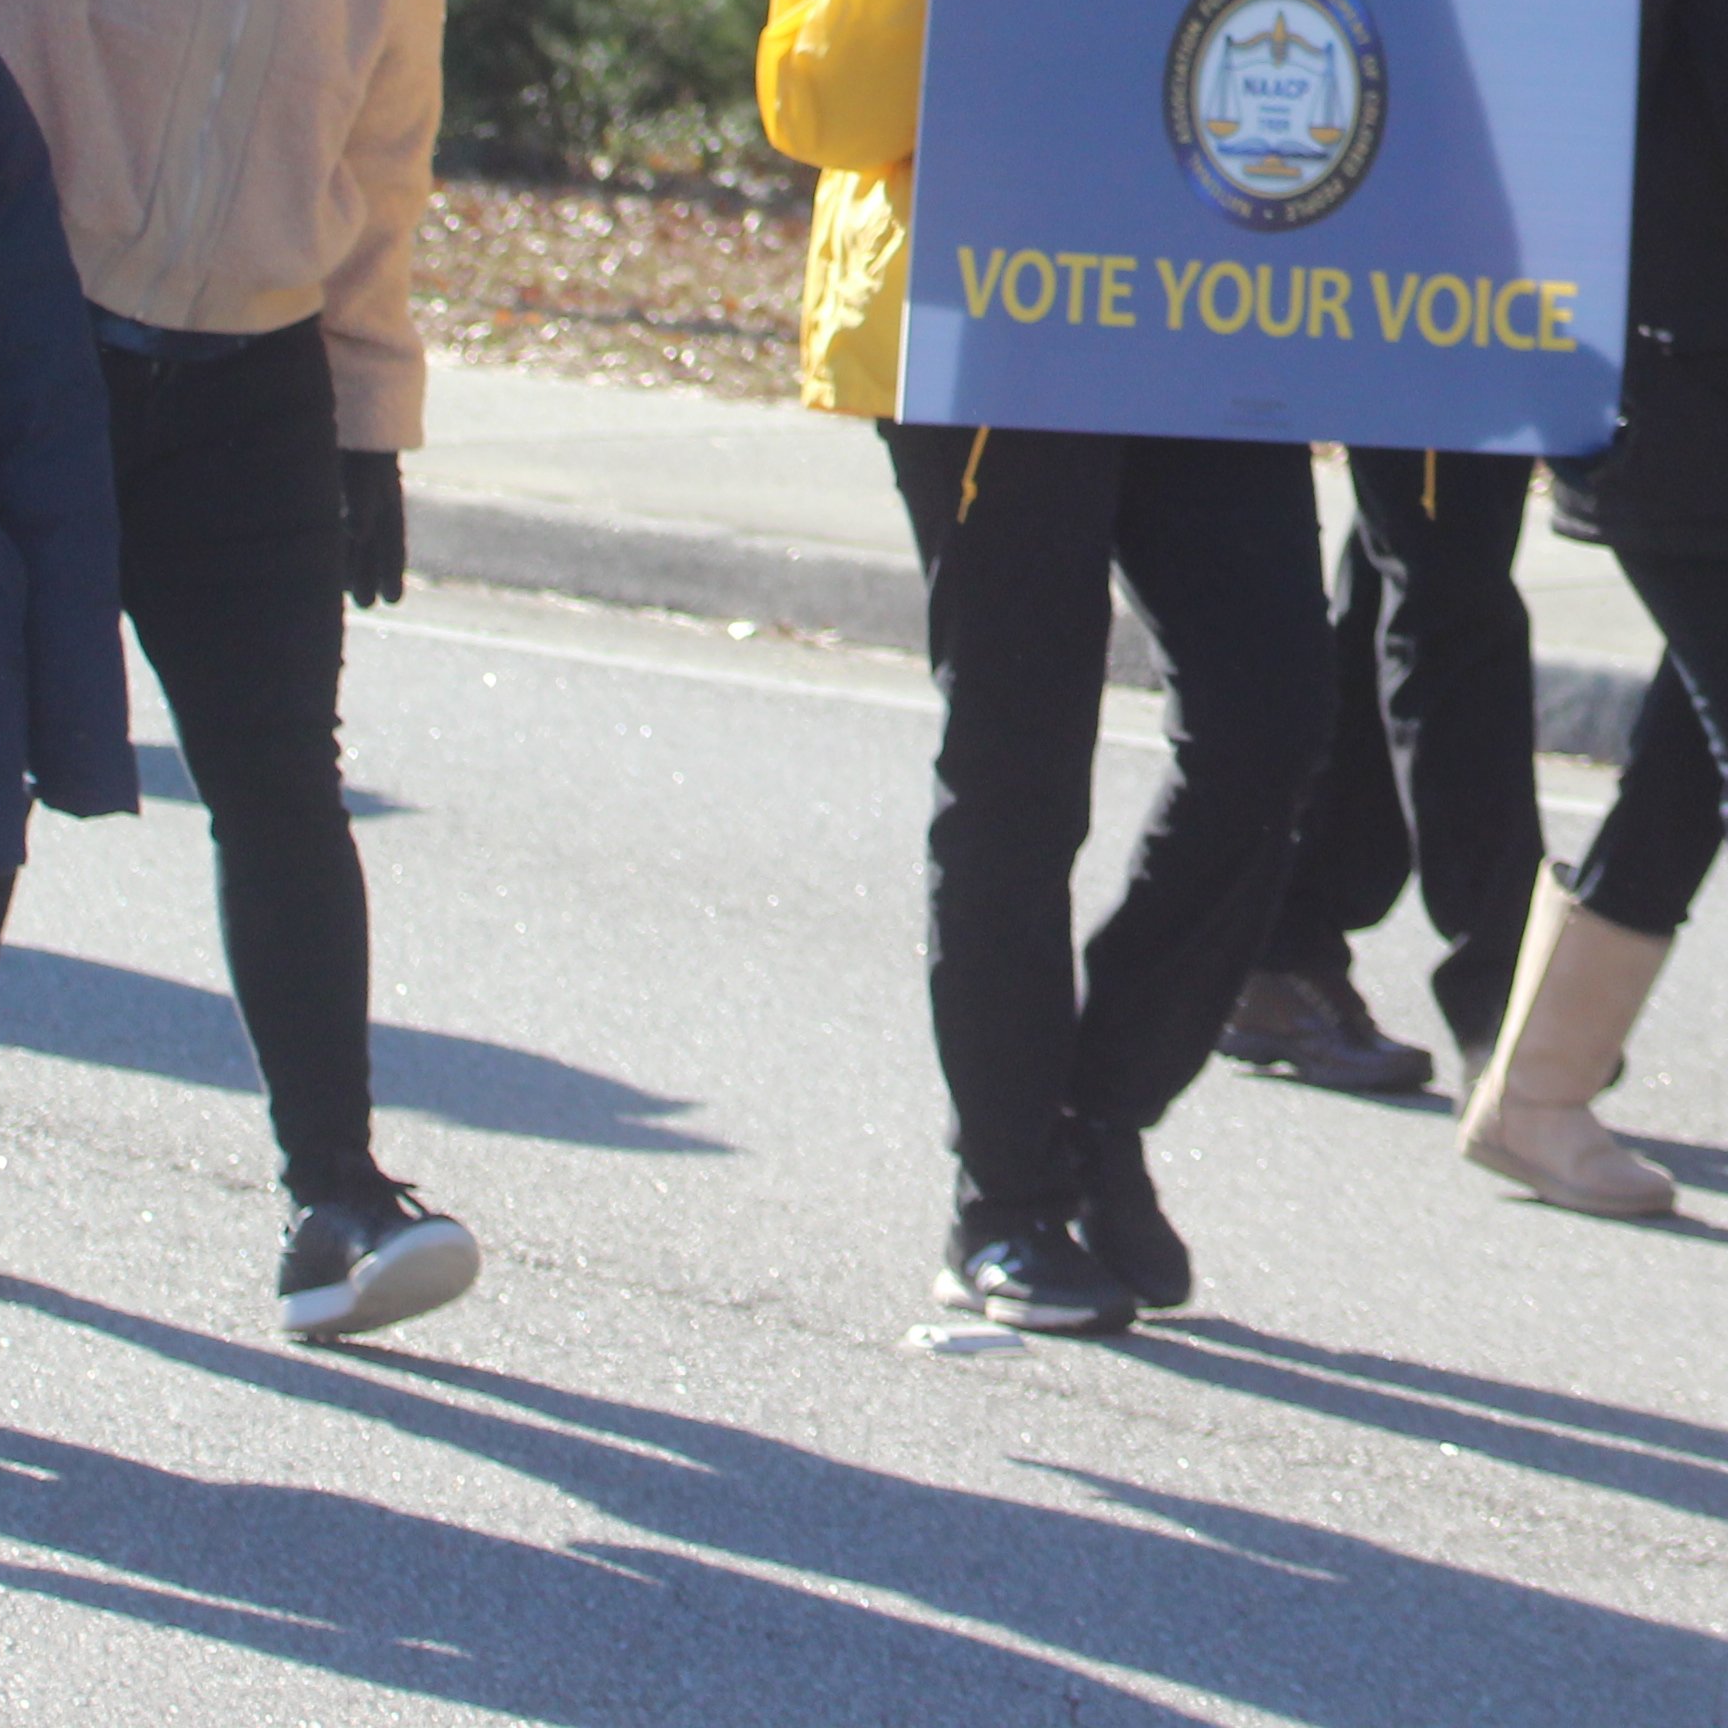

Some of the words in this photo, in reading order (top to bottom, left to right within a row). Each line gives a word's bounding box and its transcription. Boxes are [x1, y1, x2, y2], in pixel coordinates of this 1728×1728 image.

[957, 245, 1137, 327] VOTE
[1155, 258, 1353, 341] YOUR
[1371, 269, 1578, 352] VOICE
